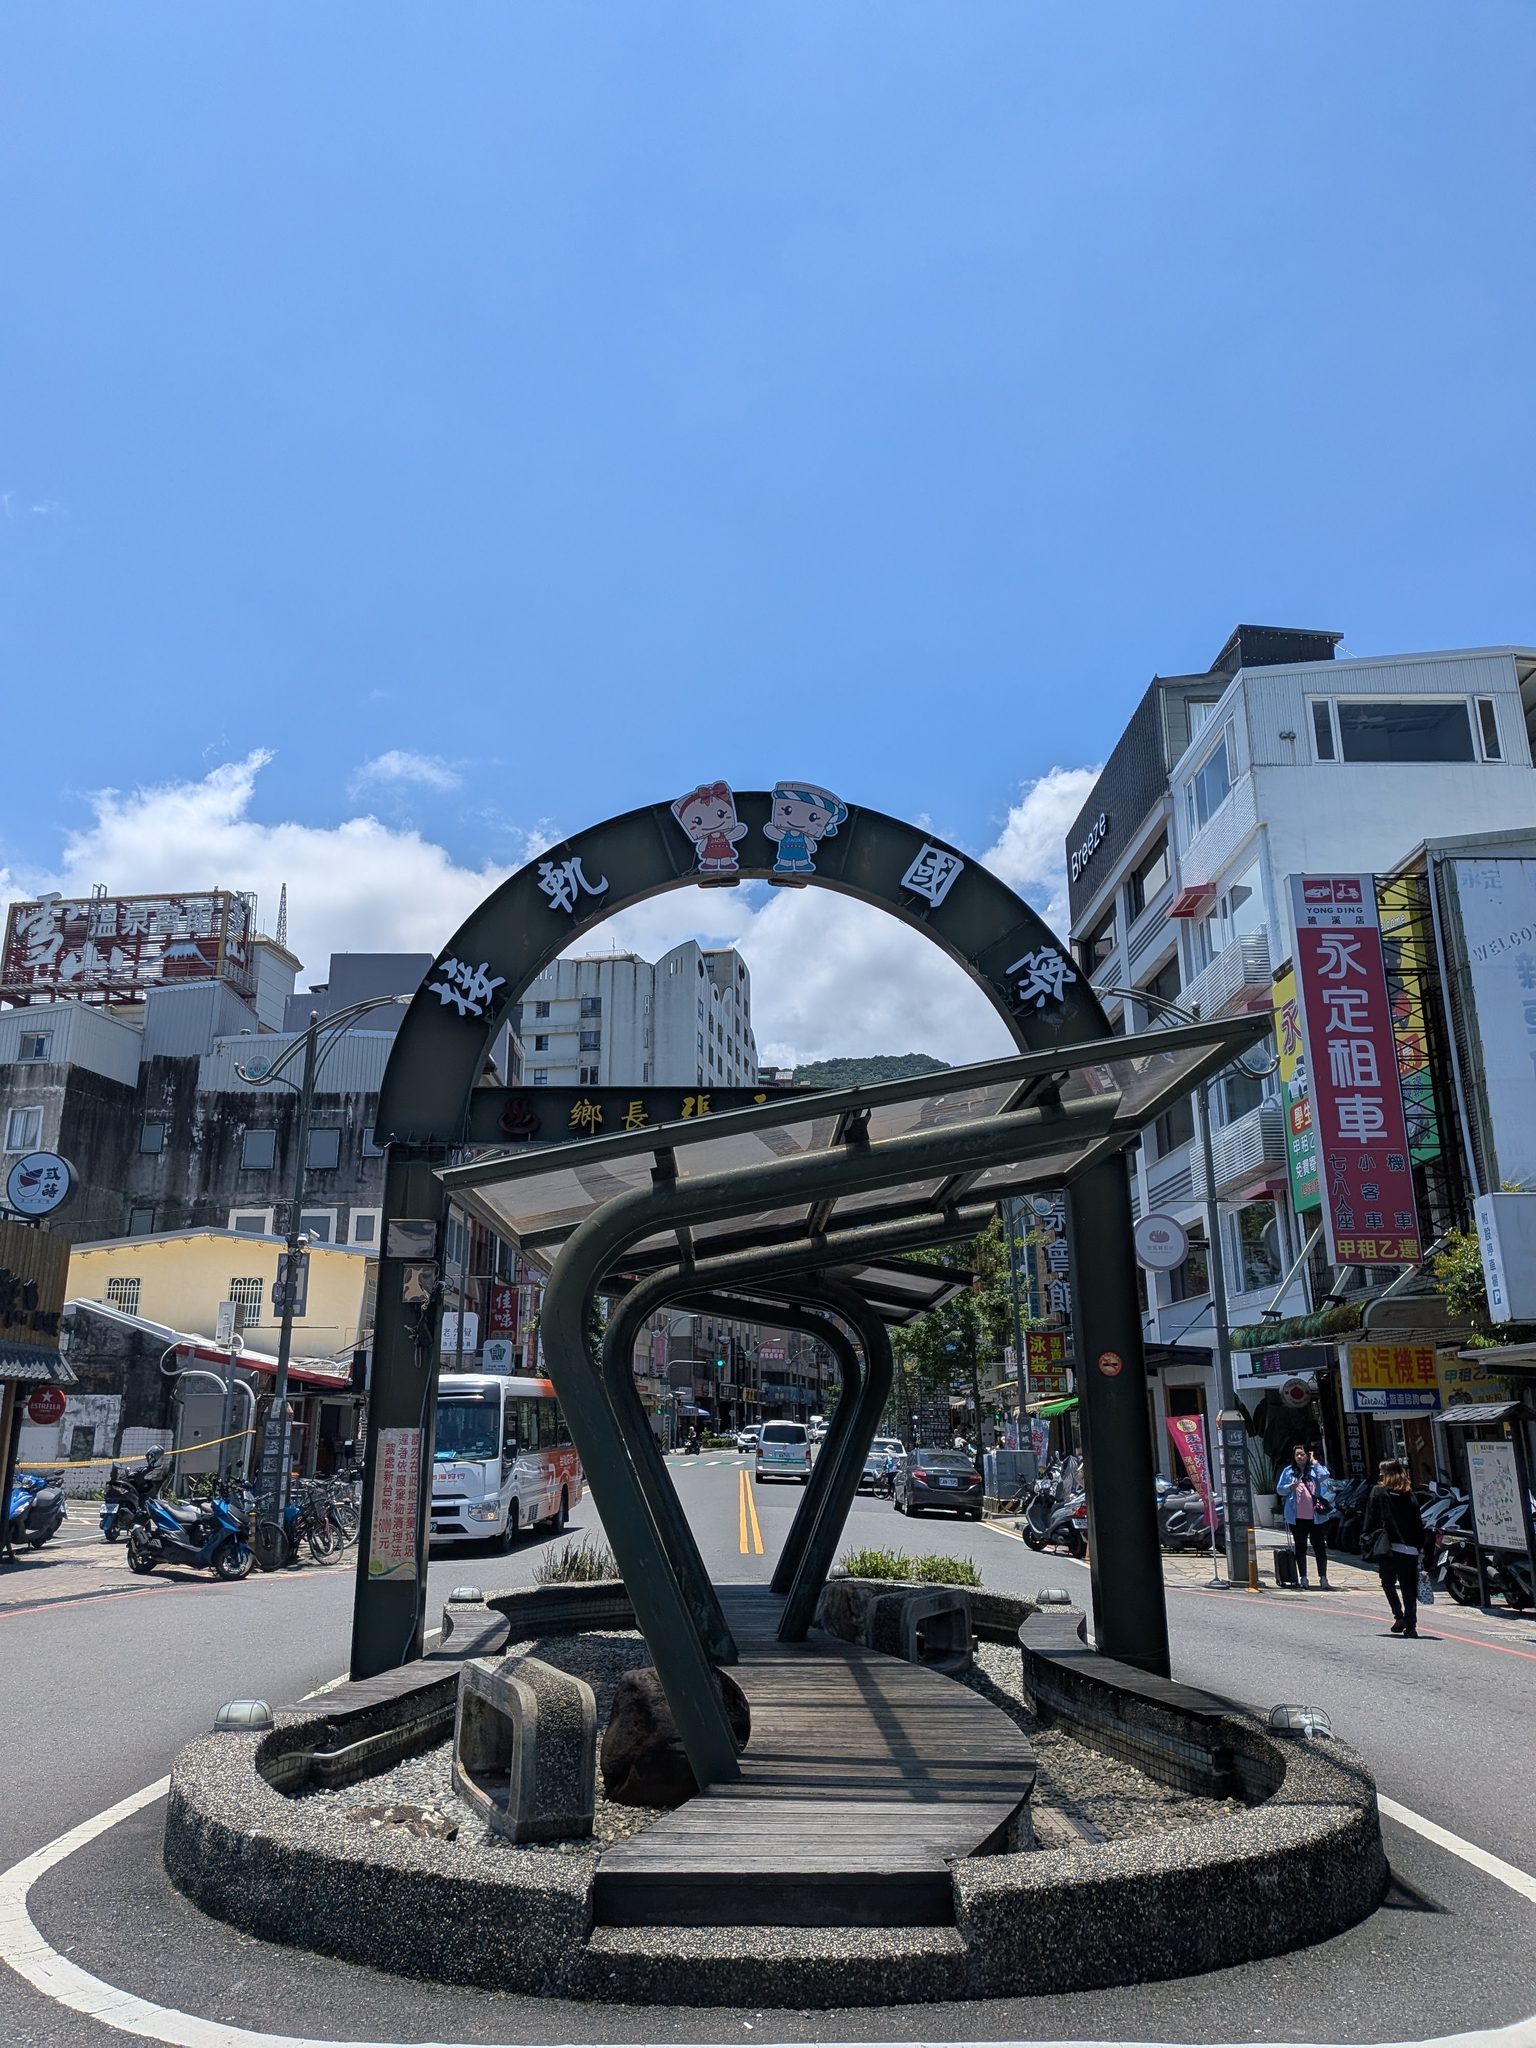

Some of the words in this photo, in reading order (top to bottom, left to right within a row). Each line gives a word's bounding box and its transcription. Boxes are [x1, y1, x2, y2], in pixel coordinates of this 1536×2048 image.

[1072, 813, 1106, 883] Breeze
[16, 892, 123, 980] 雪山
[89, 904, 214, 936] 溫泉會館
[1473, 920, 1536, 962] WELCO
[1316, 933, 1388, 1144] 永定租車
[567, 1093, 767, 1135] 鄉長張
[1358, 1153, 1384, 1230] 小客車
[1386, 1153, 1413, 1230] 機車
[1337, 1239, 1419, 1260] 甲租乙還
[1030, 1335, 1048, 1373] 泳裝
[1350, 1346, 1437, 1385] 租汽機車
[31, 1402, 61, 1410] ESTRELLA
